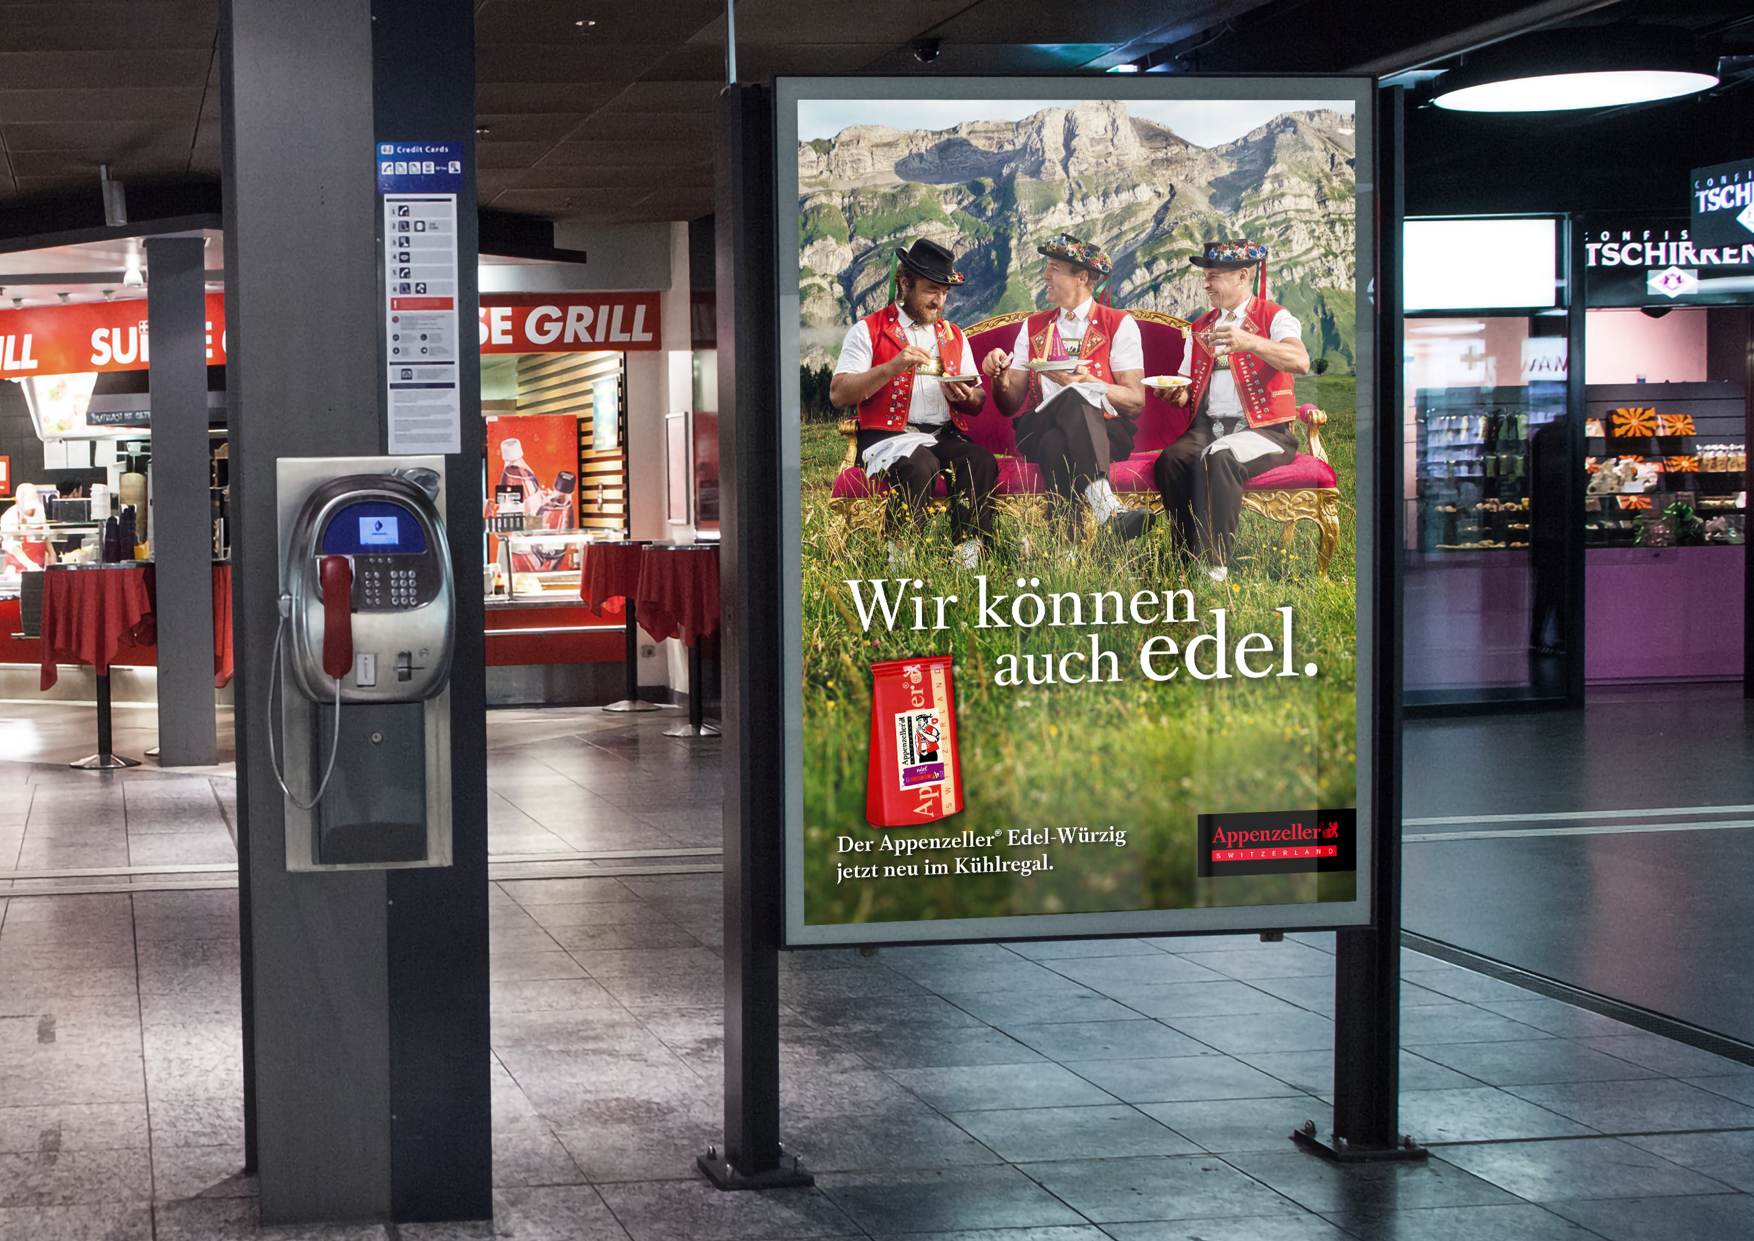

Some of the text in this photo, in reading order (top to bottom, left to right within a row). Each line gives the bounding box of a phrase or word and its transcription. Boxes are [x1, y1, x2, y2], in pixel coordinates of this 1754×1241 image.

[396, 145, 449, 154] Credit Cards
[1694, 181, 1754, 214] TSCH
[1585, 229, 1689, 242] ONFIS
[525, 304, 653, 345] GRILL
[843, 575, 1199, 633] Wir können
[994, 606, 1318, 686] auch edel.
[837, 835, 874, 853] Der
[1007, 826, 1127, 847] Edel-Würzig
[1216, 847, 1334, 859] SWITZERLAND
[836, 853, 1054, 885] jetzt neu im Kühlregal.
